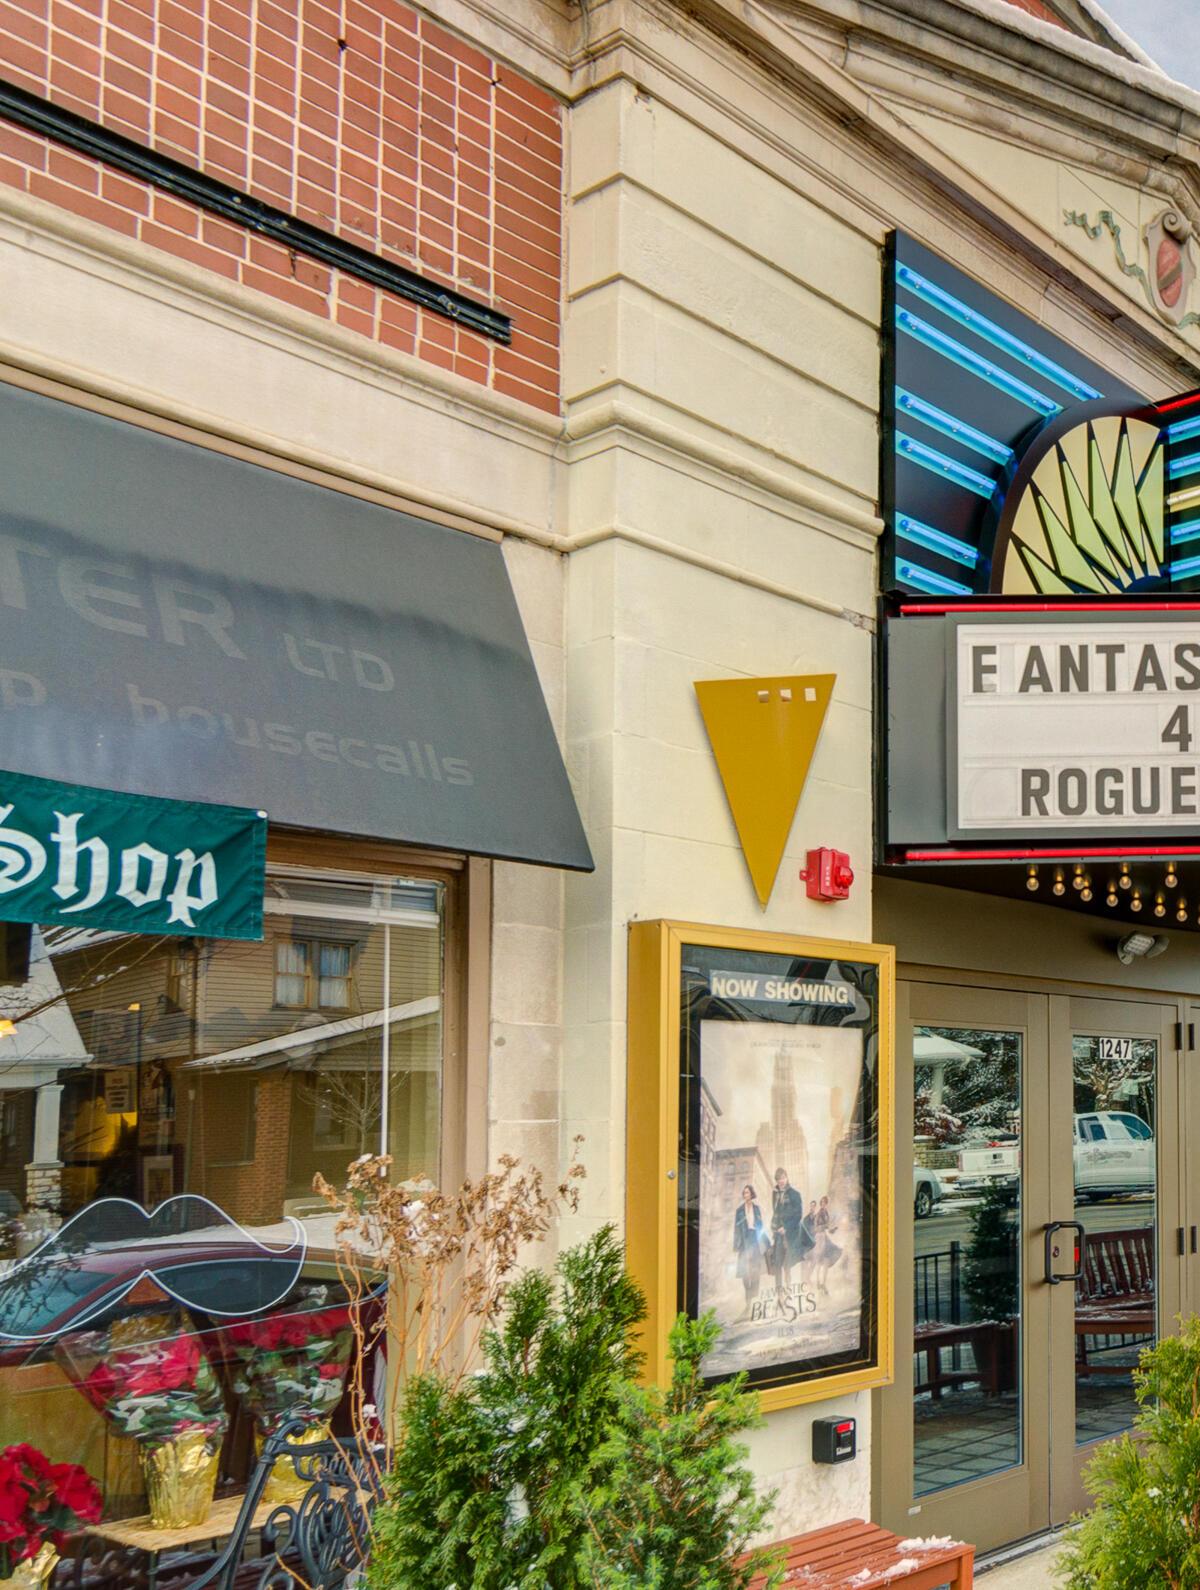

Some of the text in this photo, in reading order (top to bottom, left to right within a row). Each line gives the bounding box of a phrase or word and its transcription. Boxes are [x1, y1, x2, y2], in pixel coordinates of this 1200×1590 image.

[283, 632, 395, 692] LTD
[126, 683, 476, 788] housecalls
[1161, 705, 1192, 753] 4
[1021, 767, 1197, 817] ROGUE
[711, 977, 849, 1004] NOW SHOWING
[1100, 1040, 1131, 1059] 1247
[751, 1293, 816, 1323] BEASTS
